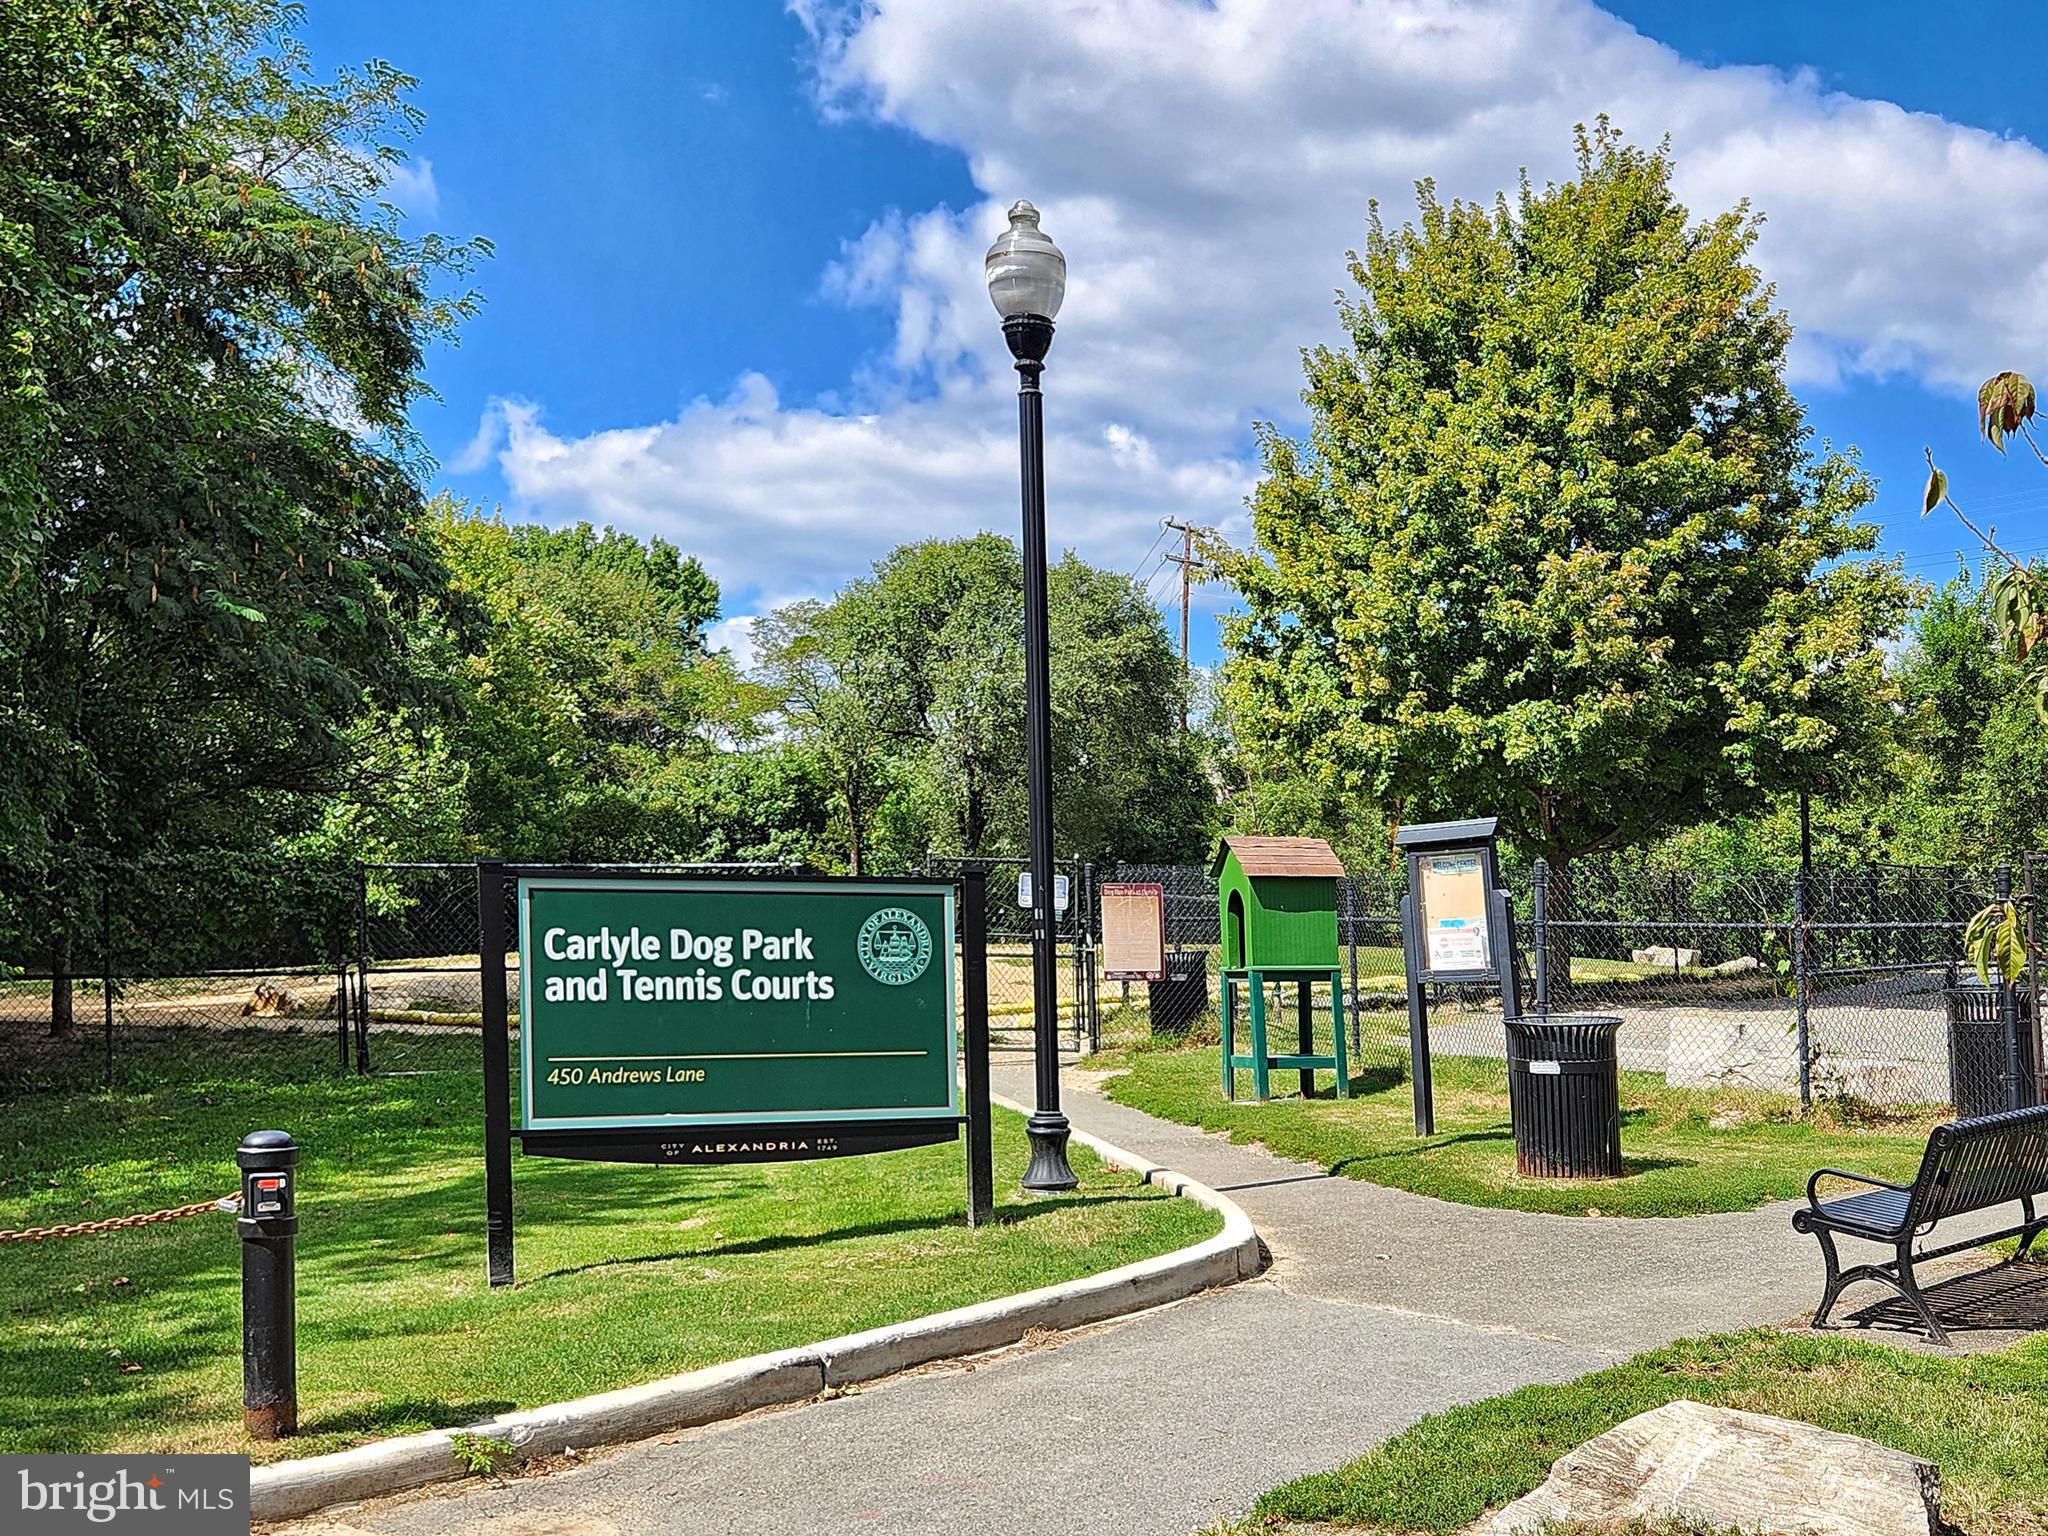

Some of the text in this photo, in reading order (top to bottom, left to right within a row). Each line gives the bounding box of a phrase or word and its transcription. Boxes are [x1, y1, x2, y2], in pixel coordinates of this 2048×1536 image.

[544, 926, 814, 968] Carlyle Dog Park
[860, 910, 930, 959] CITY OF ALEXANDRIA
[545, 967, 835, 1001] and Tennis Courts
[867, 961, 925, 983] VIRGINIA
[547, 1066, 706, 1085] 450 Andrews Lane
[691, 1141, 809, 1154] ALEXANDRIA
